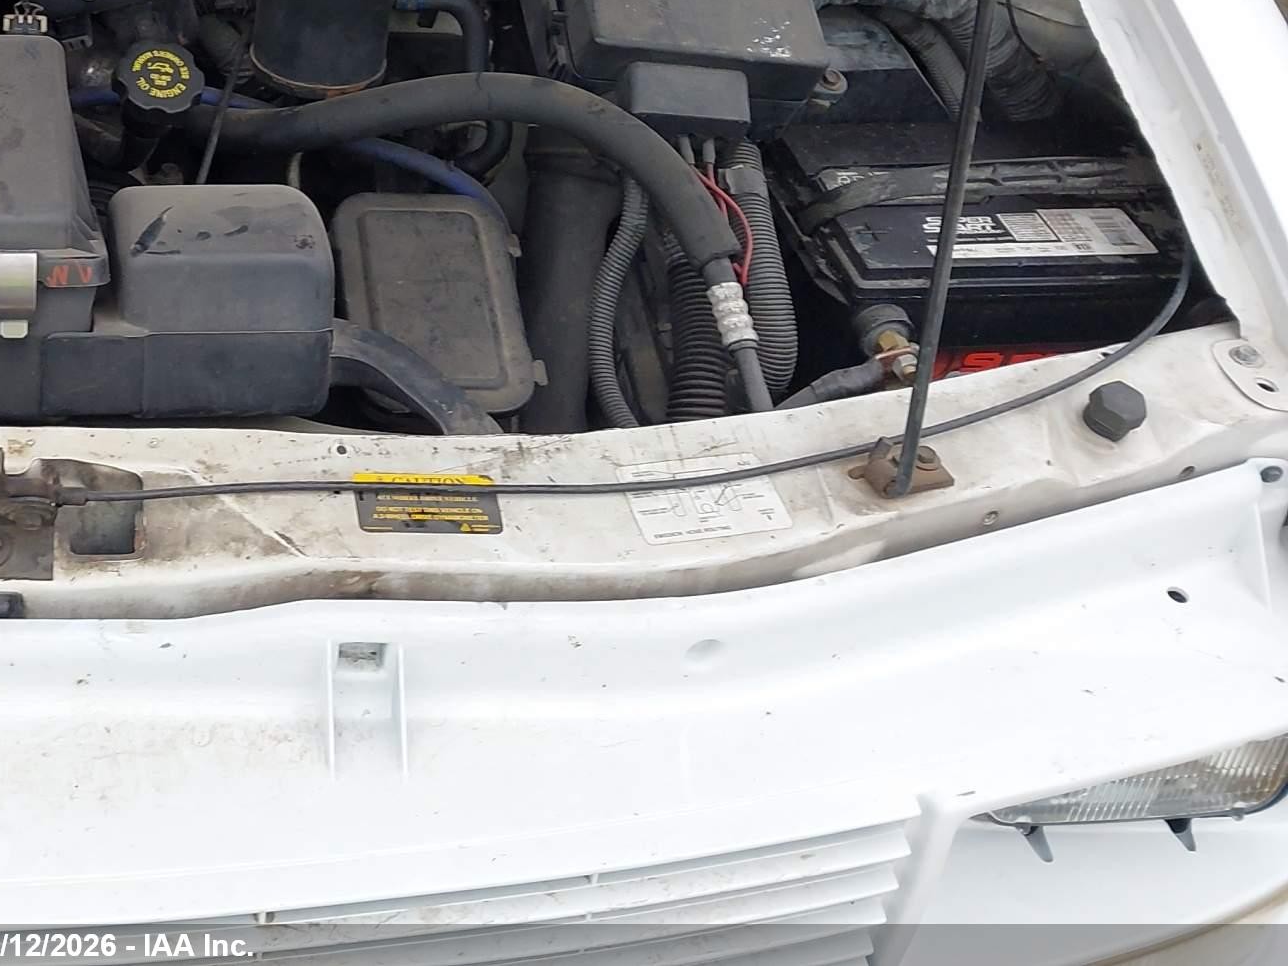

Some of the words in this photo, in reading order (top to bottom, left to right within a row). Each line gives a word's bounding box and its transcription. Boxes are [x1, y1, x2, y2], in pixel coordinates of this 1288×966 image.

[135, 76, 150, 90] OIL
[148, 82, 187, 98] ENGINE
[925, 216, 993, 224] SPER
[922, 223, 997, 233] SART
